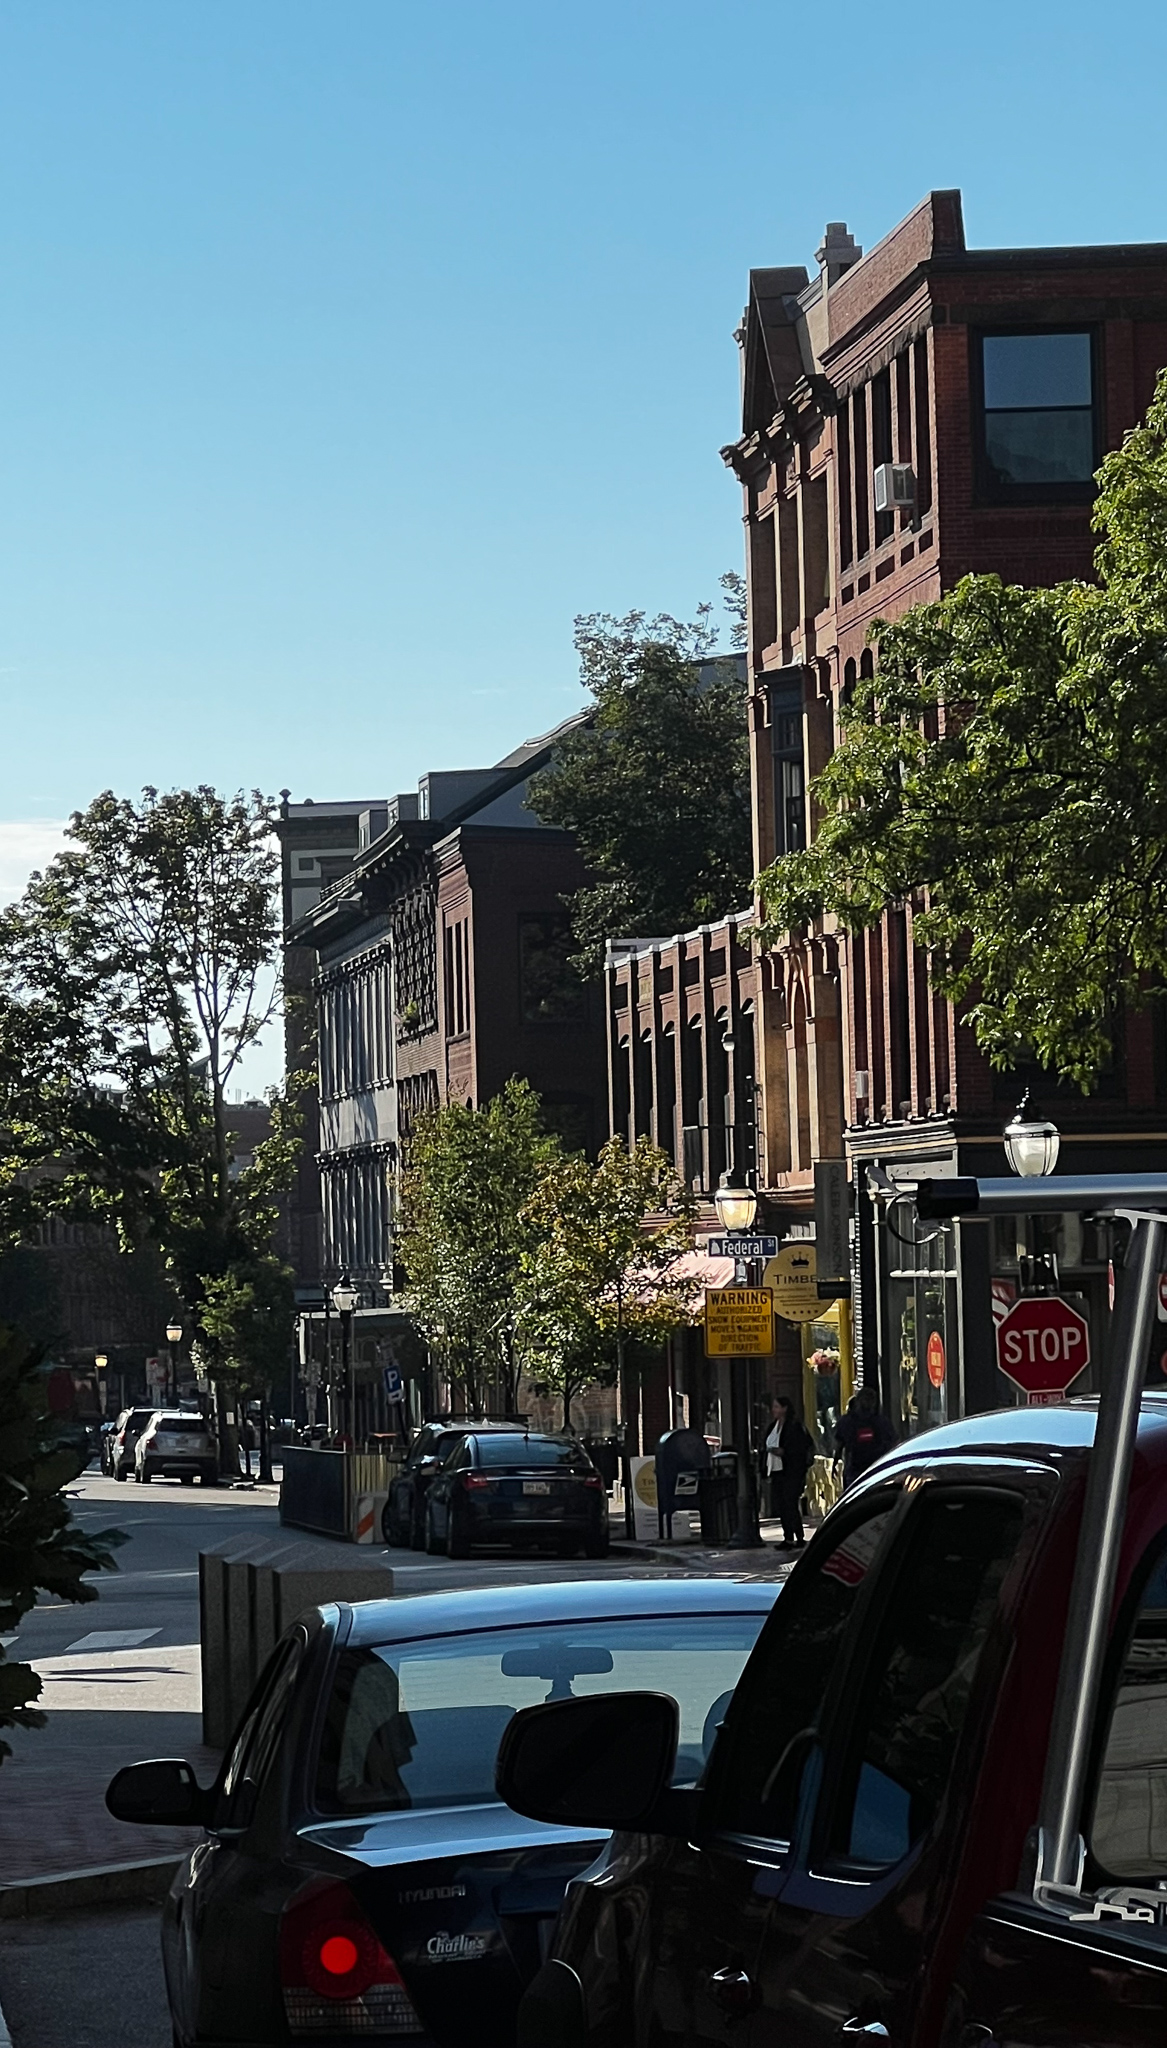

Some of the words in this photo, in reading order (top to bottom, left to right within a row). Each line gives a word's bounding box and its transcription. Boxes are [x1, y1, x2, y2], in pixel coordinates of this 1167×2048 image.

[722, 1240, 763, 1255] Federal
[767, 1239, 775, 1247] St
[831, 1209, 842, 1274] JOHNSON
[710, 1292, 768, 1305] WARNING
[716, 1306, 763, 1314] AUTHORIZED
[708, 1315, 728, 1324] SNOW
[731, 1315, 770, 1324] EQUIPMENT
[710, 1325, 735, 1333] MOVES
[737, 1325, 767, 1333] AGAINST
[720, 1334, 759, 1343] DIRECTION
[1004, 1326, 1081, 1364] STOP
[718, 1343, 727, 1352] OF
[731, 1342, 761, 1351] TRAFFIC
[387, 1370, 398, 1390] P
[398, 1883, 466, 1904] HYUNDAI
